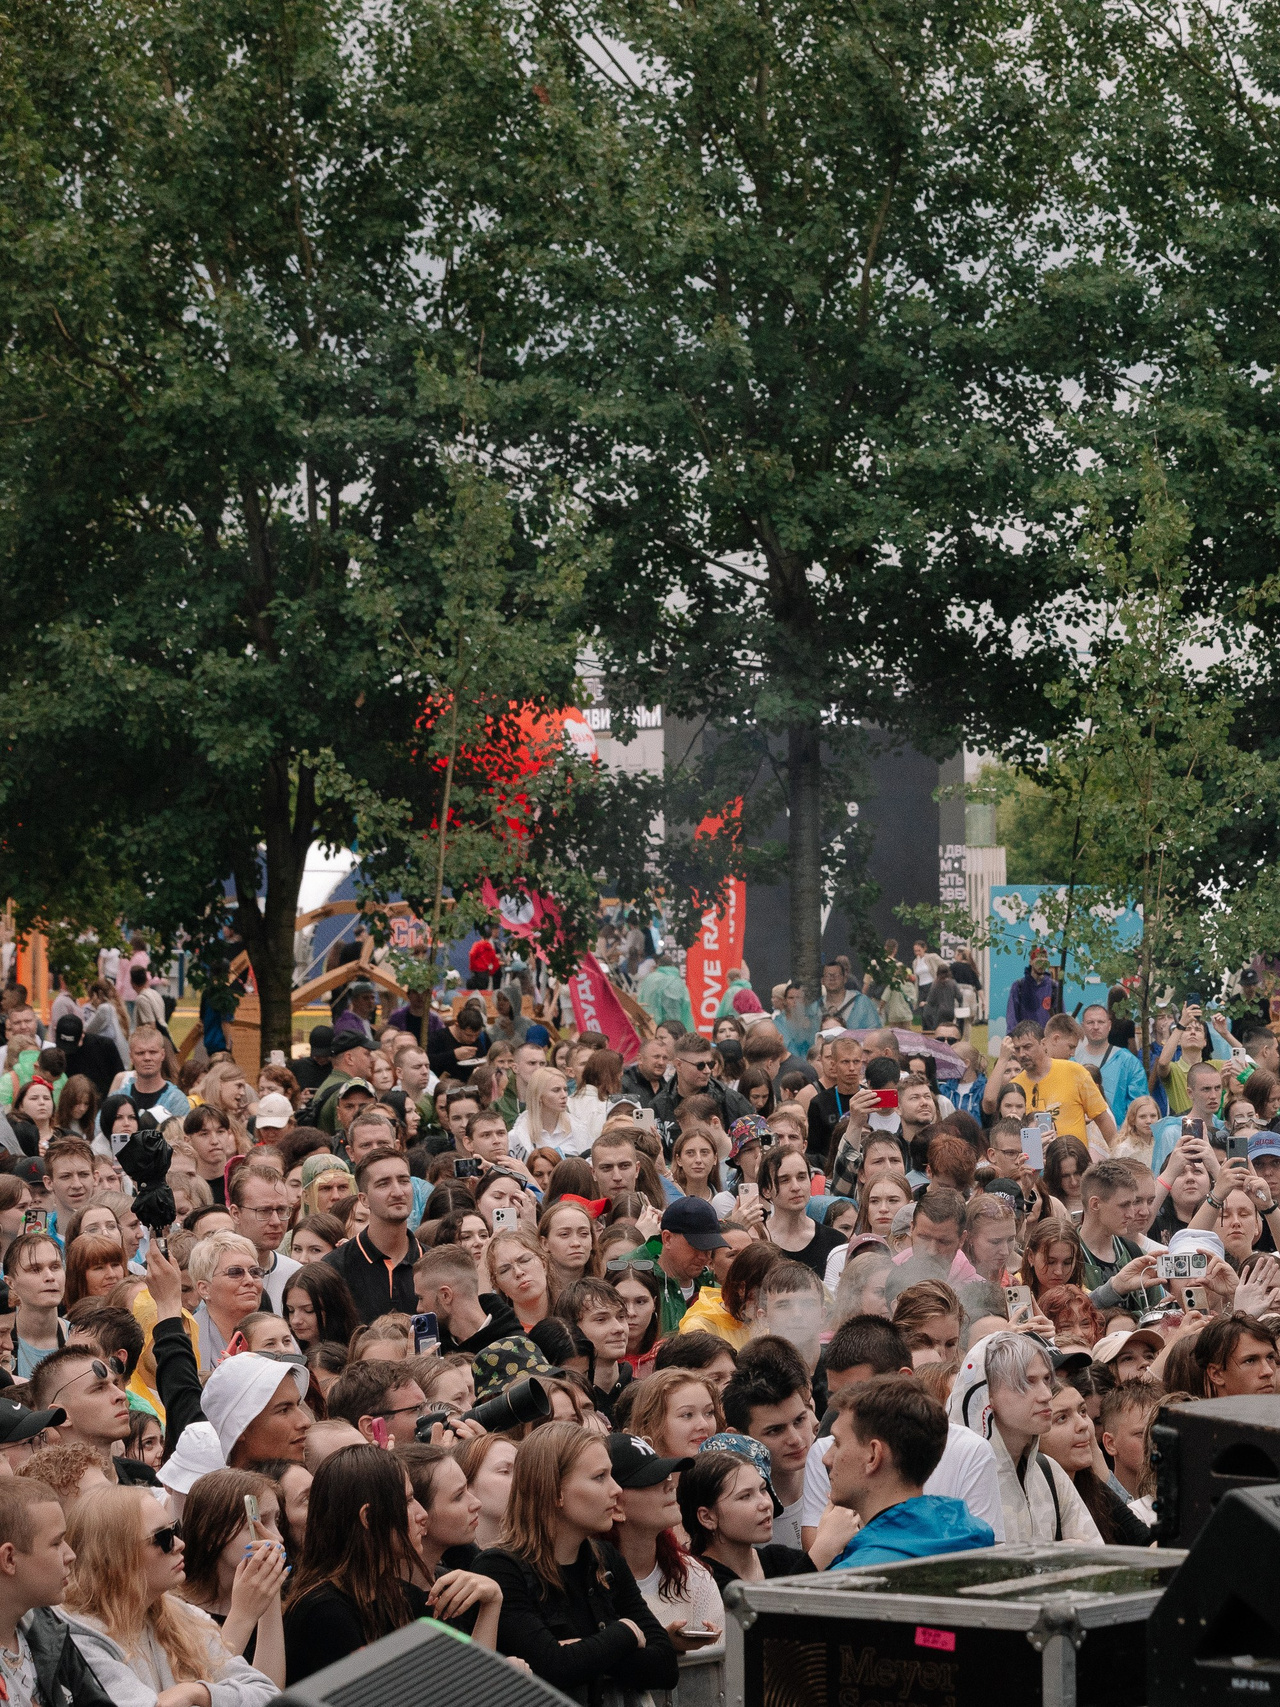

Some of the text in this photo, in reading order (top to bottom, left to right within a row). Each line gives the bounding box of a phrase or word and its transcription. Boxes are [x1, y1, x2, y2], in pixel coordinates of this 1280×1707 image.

[582, 704, 662, 730] ДВИНИИ
[702, 896, 720, 951] RA
[838, 1645, 959, 1698] Meyer
